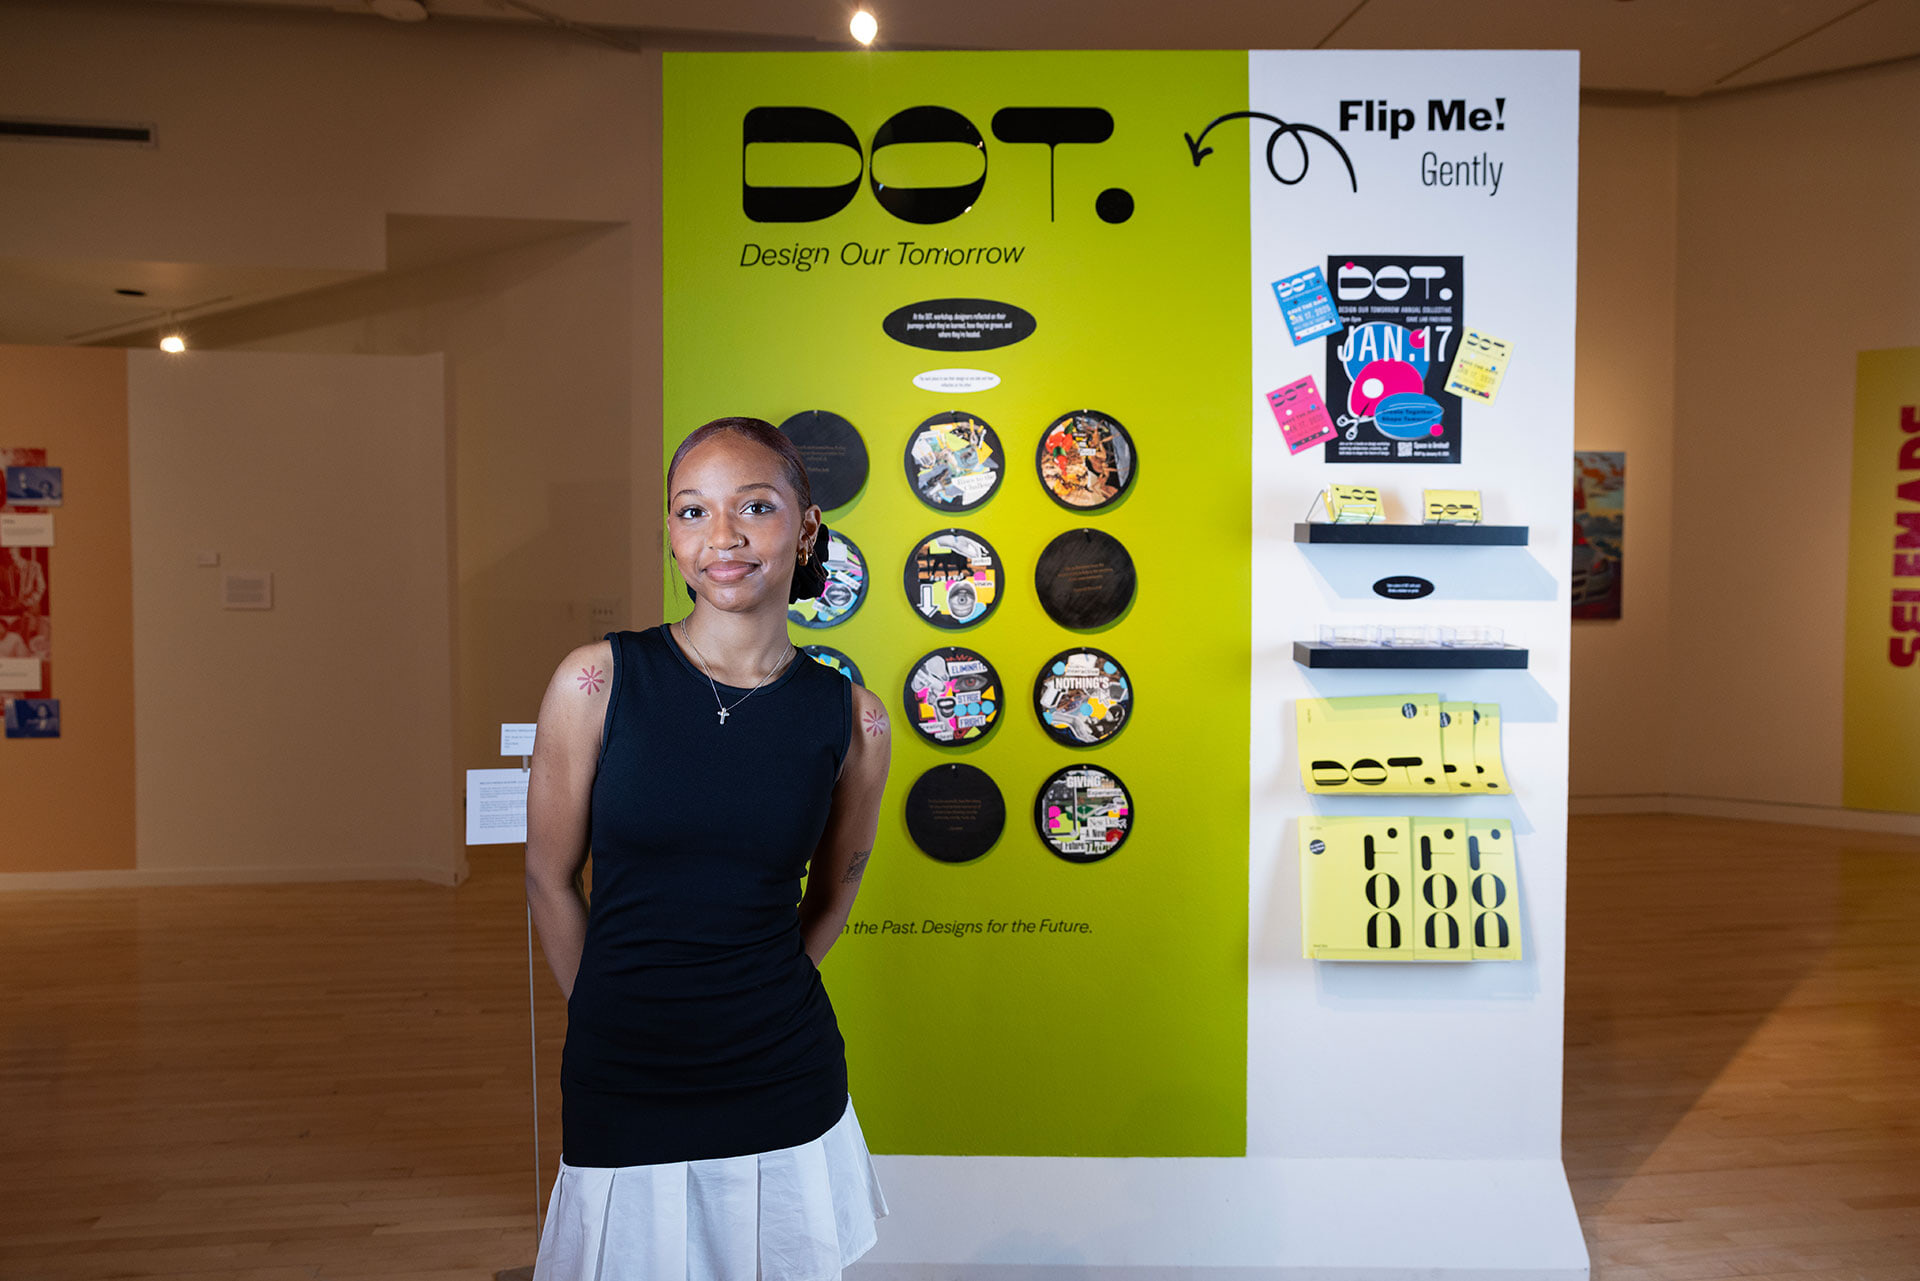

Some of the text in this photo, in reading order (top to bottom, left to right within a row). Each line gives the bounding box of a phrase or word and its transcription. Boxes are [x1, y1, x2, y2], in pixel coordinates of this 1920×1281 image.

[1339, 97, 1506, 140] Flip Me!
[743, 105, 1135, 225] DOT.
[1421, 151, 1504, 197] Gently
[740, 241, 1026, 272] Design Our Tomorrow
[1338, 265, 1453, 301] DOT.
[1055, 677, 1110, 690] NOTHING'S
[1066, 775, 1101, 788] GIVING
[1311, 757, 1436, 786] DOT.
[853, 921, 878, 935] the
[881, 920, 918, 935] Past.
[921, 920, 983, 938] Designs
[985, 919, 1008, 934] for
[1011, 919, 1036, 934] the
[1039, 918, 1093, 934] Future.
